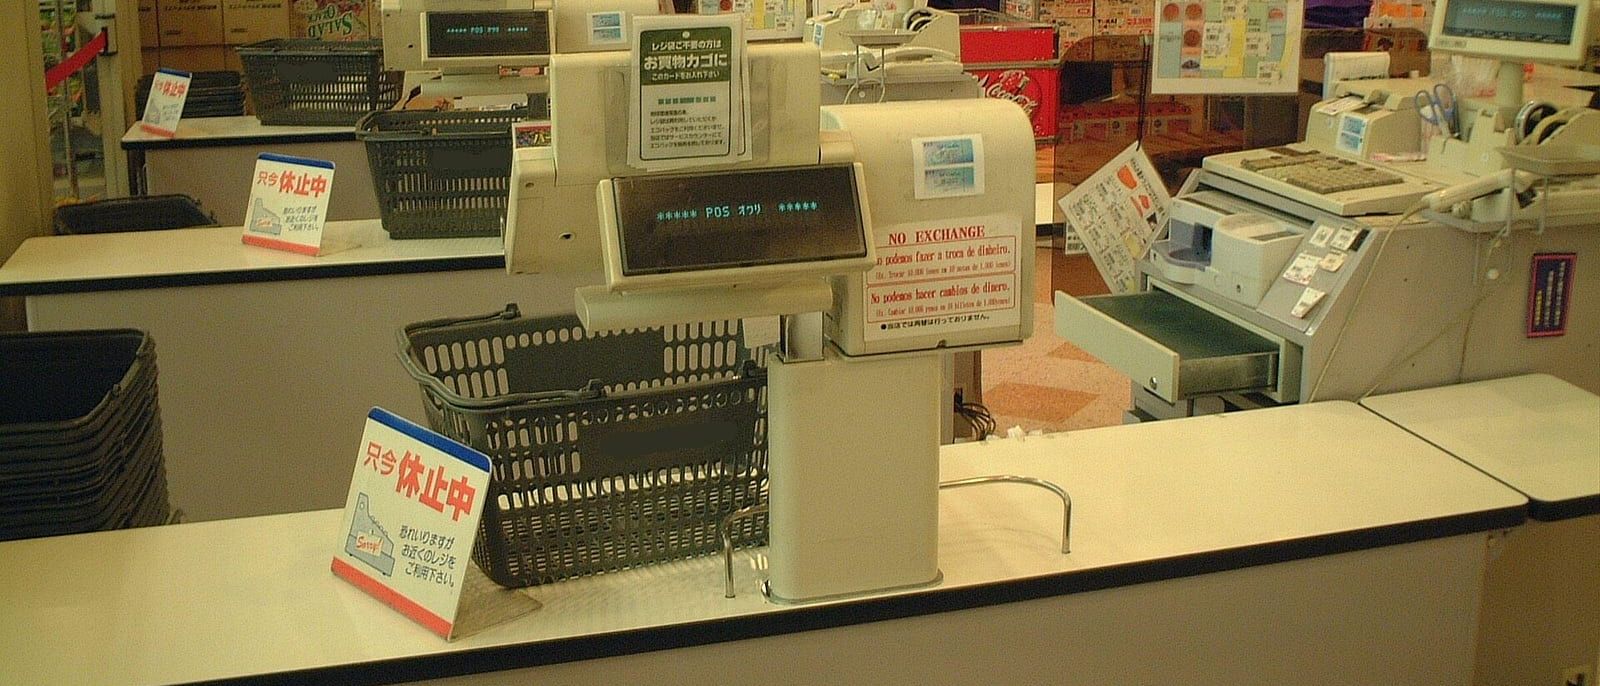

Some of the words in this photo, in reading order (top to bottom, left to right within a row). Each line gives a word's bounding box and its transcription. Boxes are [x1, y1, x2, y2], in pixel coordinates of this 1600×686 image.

[308, 11, 353, 38] SALAD
[643, 52, 728, 71] お買物カゴに
[257, 170, 327, 198] 只今休止中
[705, 205, 730, 218] POS
[888, 232, 907, 246] NO
[915, 225, 985, 244] EXCHANGE
[885, 253, 913, 266] podemos
[945, 249, 964, 260] troca
[967, 246, 975, 257] de
[870, 292, 880, 305] No
[883, 290, 912, 304] podemos
[915, 287, 936, 299] hacer
[971, 283, 980, 295] de
[363, 440, 476, 522] 只今休止中
[399, 525, 455, 551] 恐れいりますが
[401, 544, 456, 570] お近くのレジを
[405, 561, 455, 588] ご利用下さい。
